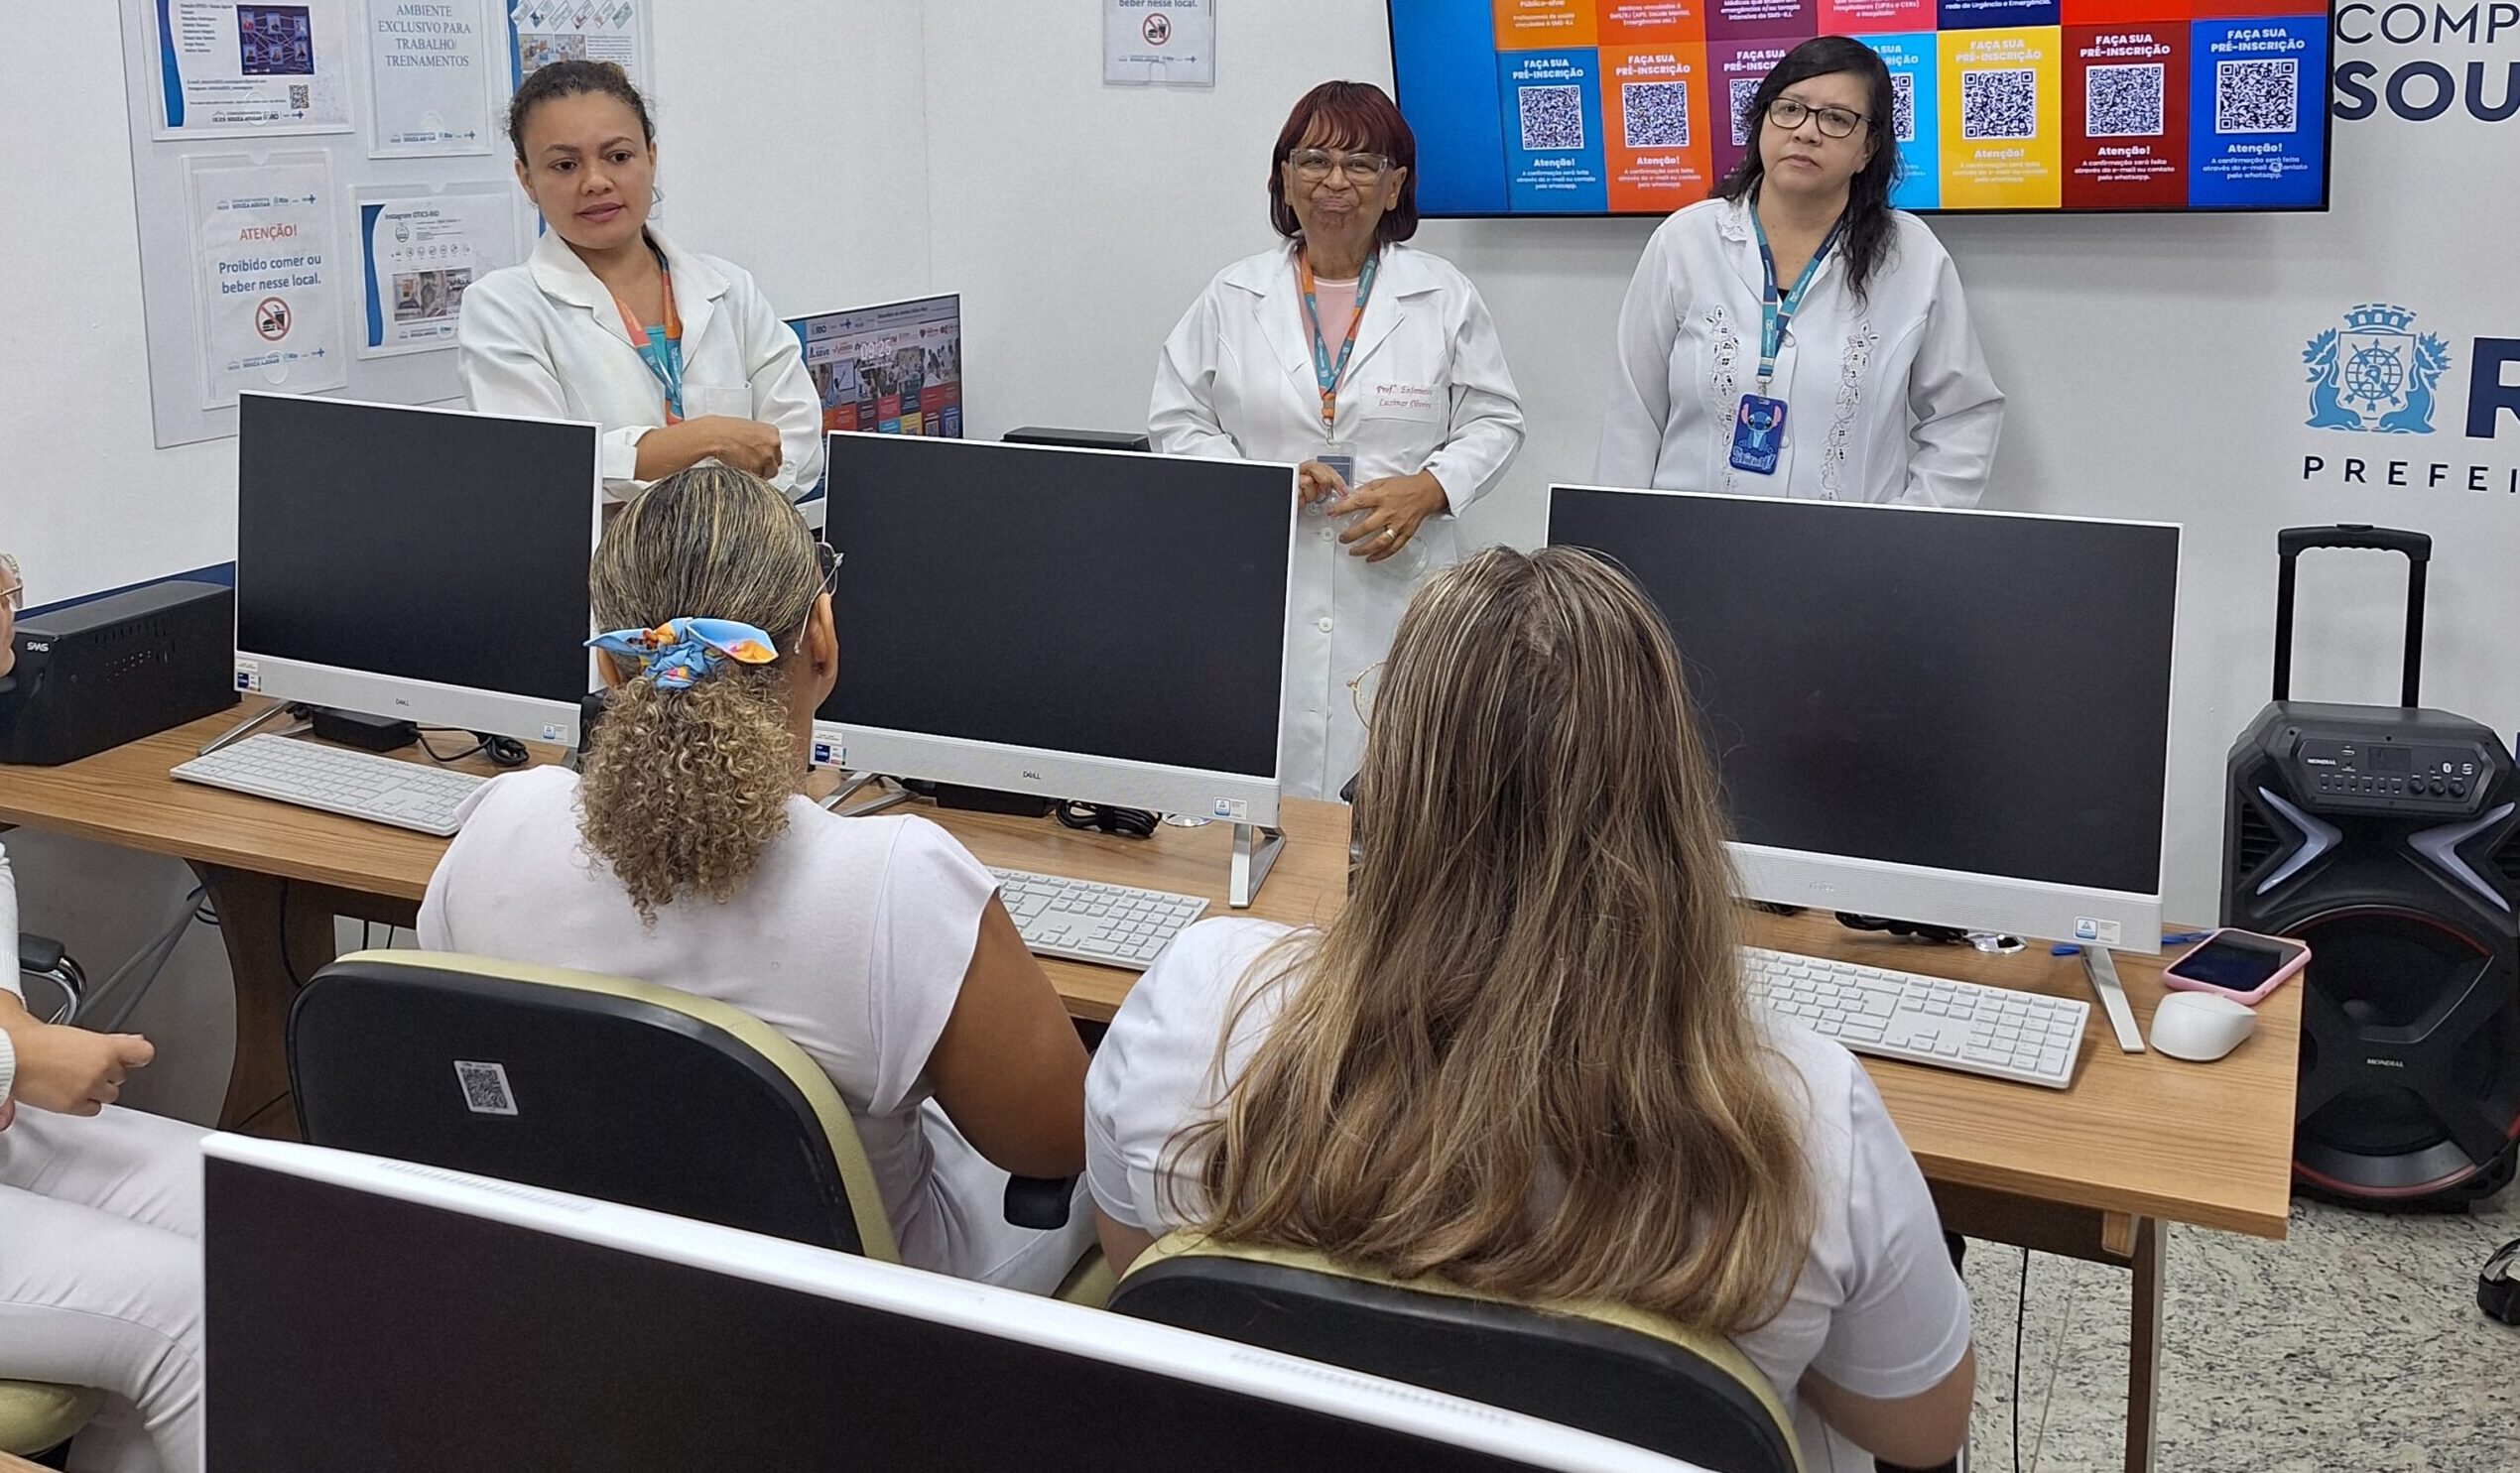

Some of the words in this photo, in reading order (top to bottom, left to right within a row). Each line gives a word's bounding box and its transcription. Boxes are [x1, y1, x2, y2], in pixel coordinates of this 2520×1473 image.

[397, 4, 451, 17] AMBIENTE
[378, 21, 441, 33] EXCLUSIVO
[443, 22, 471, 34] PARA
[2335, 3, 2520, 44] COMP
[2095, 35, 2128, 47] FAÇA
[2128, 34, 2153, 44] SUA
[2227, 30, 2260, 41] FAÇA
[2262, 28, 2287, 38] SUA
[1881, 45, 1902, 54] SUA
[1970, 41, 1999, 52] FAÇA
[2002, 40, 2024, 49] SUA
[2079, 44, 2171, 58] PRÉ-INSCRIÇÃO
[2210, 39, 2306, 53] PRÉ-INSCRIÇÃO
[385, 55, 469, 67] TREINAMENTOS
[1628, 56, 1654, 65] FAÇA
[1655, 54, 1676, 63] SUA
[1736, 51, 1764, 61] FAÇA
[1765, 50, 1786, 59] SUA
[1955, 50, 2042, 63] PRÉ-INSCRIÇÃO
[1524, 60, 1549, 69] FAÇA
[1550, 59, 1570, 67] SUA
[1615, 62, 1691, 76] PRÉ-INSCRIÇÃO
[1512, 67, 1584, 79] PRÉ-INSCRIÇÃO
[2332, 60, 2520, 122] SOU
[1973, 148, 2024, 160] Atenção!
[2097, 146, 2151, 158] Atenção!
[2227, 143, 2283, 155] Atenção!
[1534, 158, 1575, 169] Atenção!
[1636, 156, 1681, 167] Atenção!
[240, 223, 298, 241] ATENÇÃO!
[218, 258, 267, 274] Proibido
[270, 256, 304, 269] comer
[307, 255, 321, 265] ou
[221, 280, 256, 294] beber
[259, 277, 290, 290] nesse
[292, 272, 321, 287] local.
[860, 340, 892, 360] 09:25
[2303, 455, 2518, 494] PREFEI
[27, 641, 49, 652] SMS
[1023, 771, 1041, 780] DELL
[2366, 1058, 2404, 1068] MONDIAL
